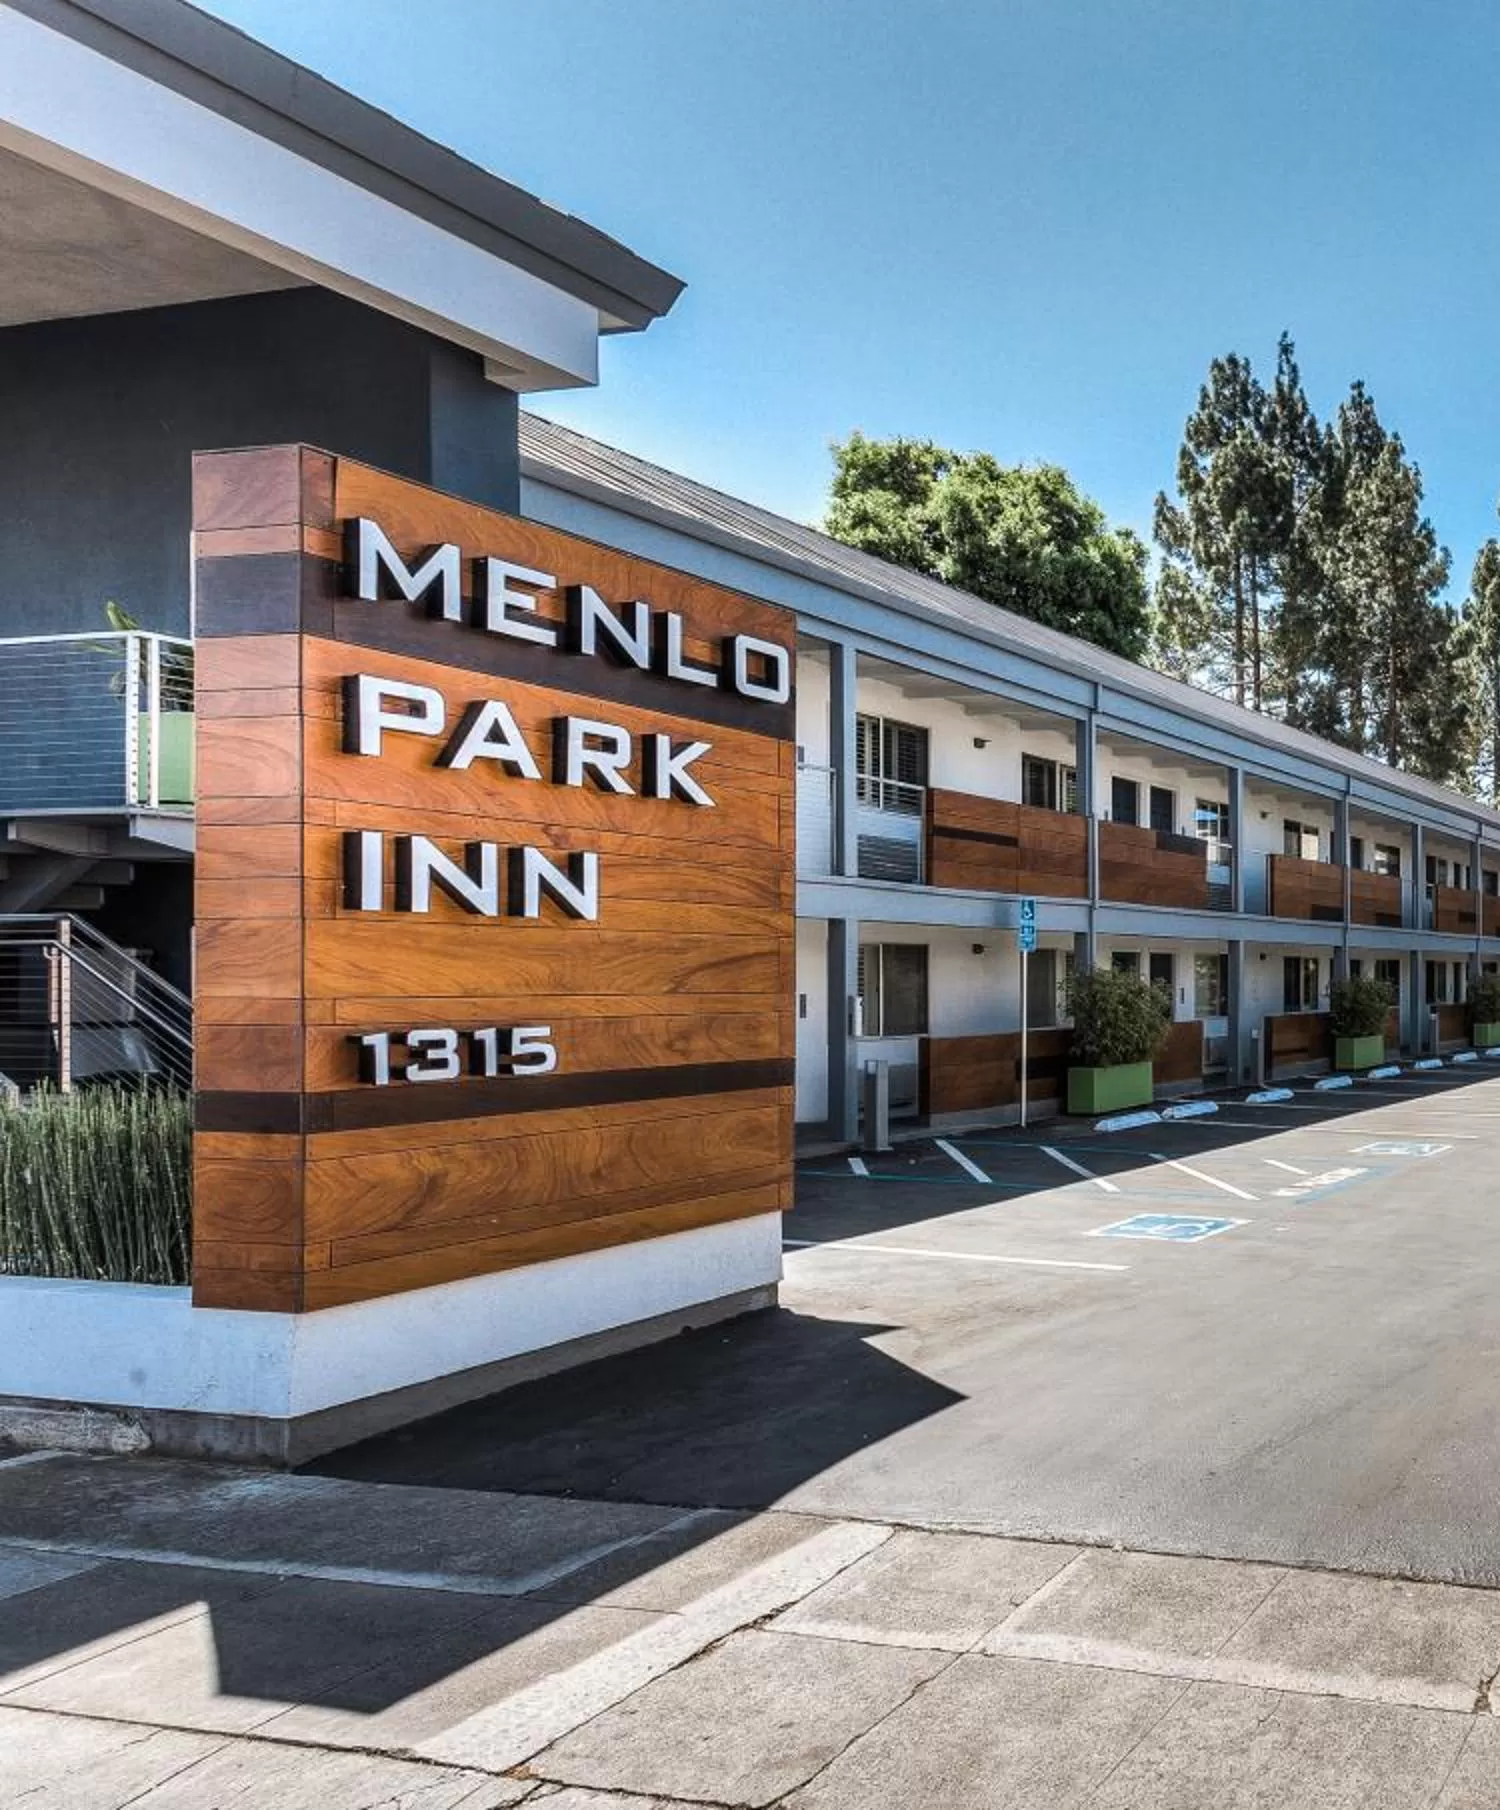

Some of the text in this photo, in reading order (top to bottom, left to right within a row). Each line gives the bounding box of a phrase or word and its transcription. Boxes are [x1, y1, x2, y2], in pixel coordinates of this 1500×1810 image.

[357, 517, 790, 705] MENLO
[357, 673, 715, 806] PARK
[360, 831, 598, 921] INN
[361, 1025, 559, 1085] 1315
